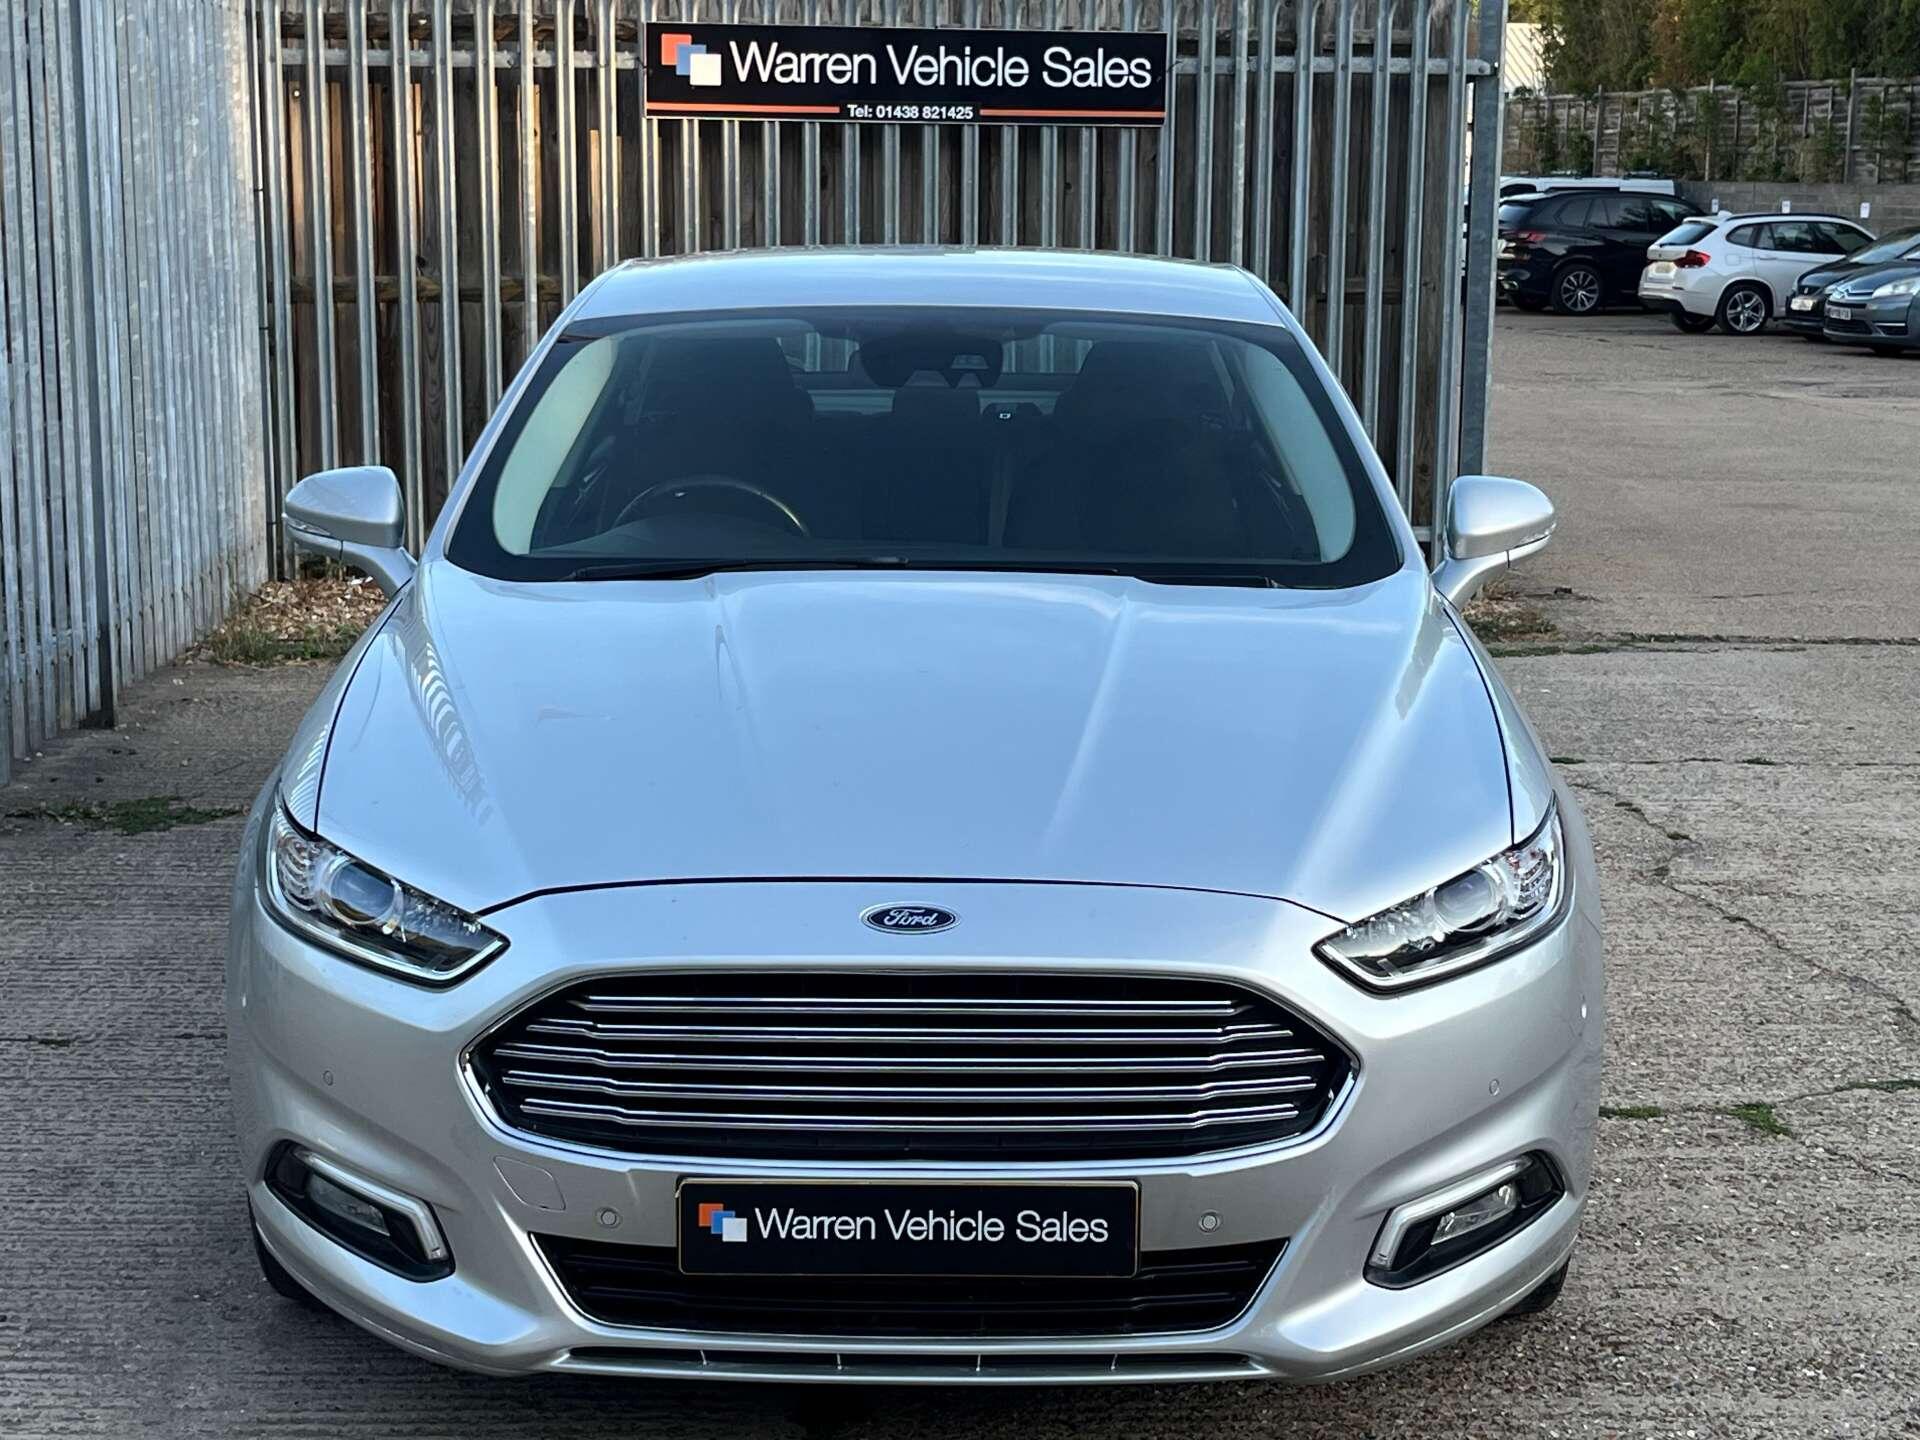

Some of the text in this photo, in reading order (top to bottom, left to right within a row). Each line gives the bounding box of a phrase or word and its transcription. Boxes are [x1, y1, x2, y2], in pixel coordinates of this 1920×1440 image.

[729, 40, 1152, 89] Warren Vehicle Sales
[846, 103, 974, 120] Tel: 01438 821425
[883, 908, 938, 926] Ford
[754, 1207, 1109, 1243] Warren Vehicle Sales
